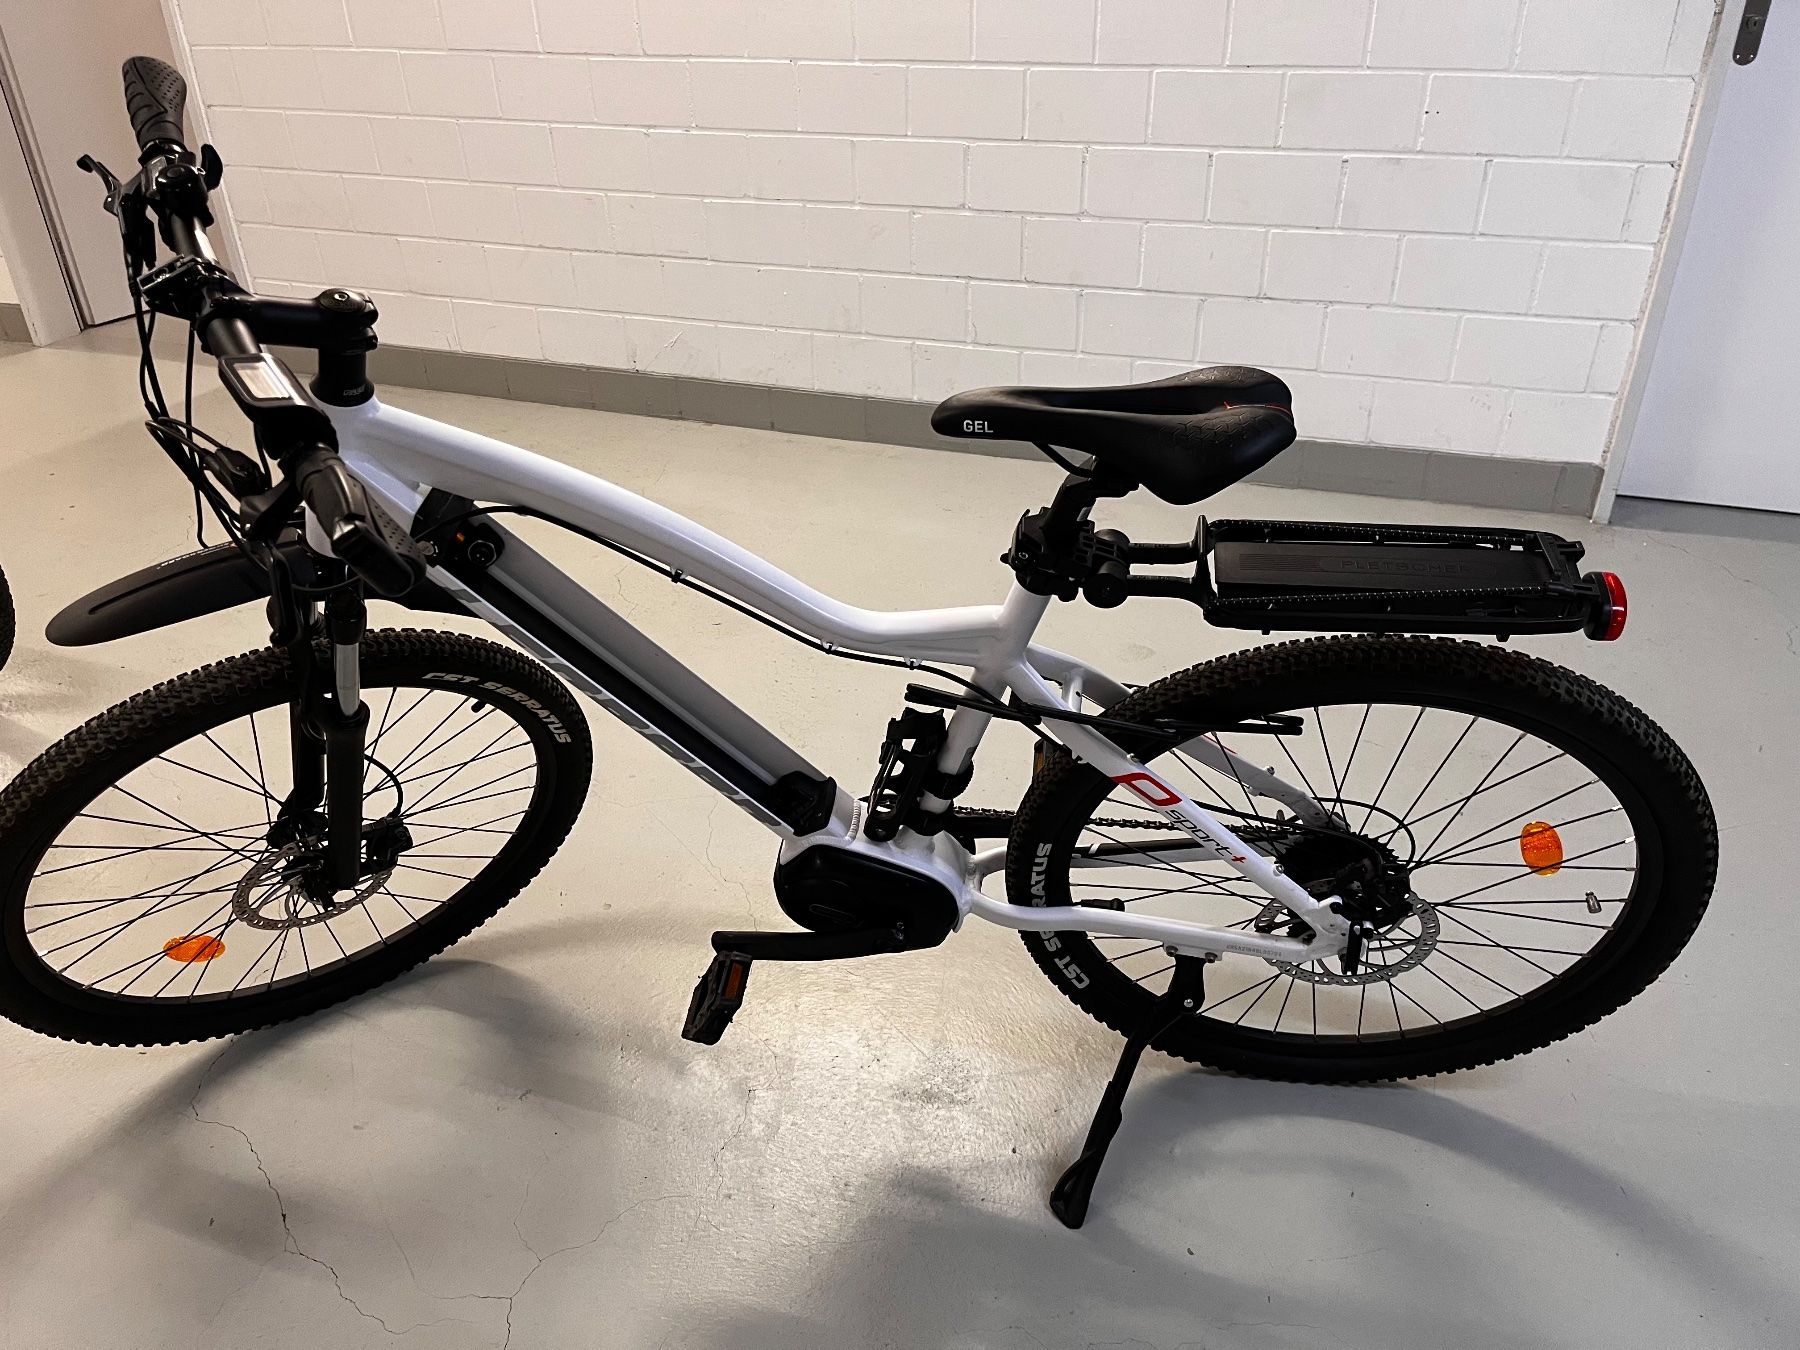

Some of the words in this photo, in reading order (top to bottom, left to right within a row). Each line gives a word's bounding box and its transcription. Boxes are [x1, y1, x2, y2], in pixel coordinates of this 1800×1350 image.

[963, 419, 994, 433] GEL
[479, 681, 572, 744] SERRATUS
[1054, 955, 1090, 989] CST
